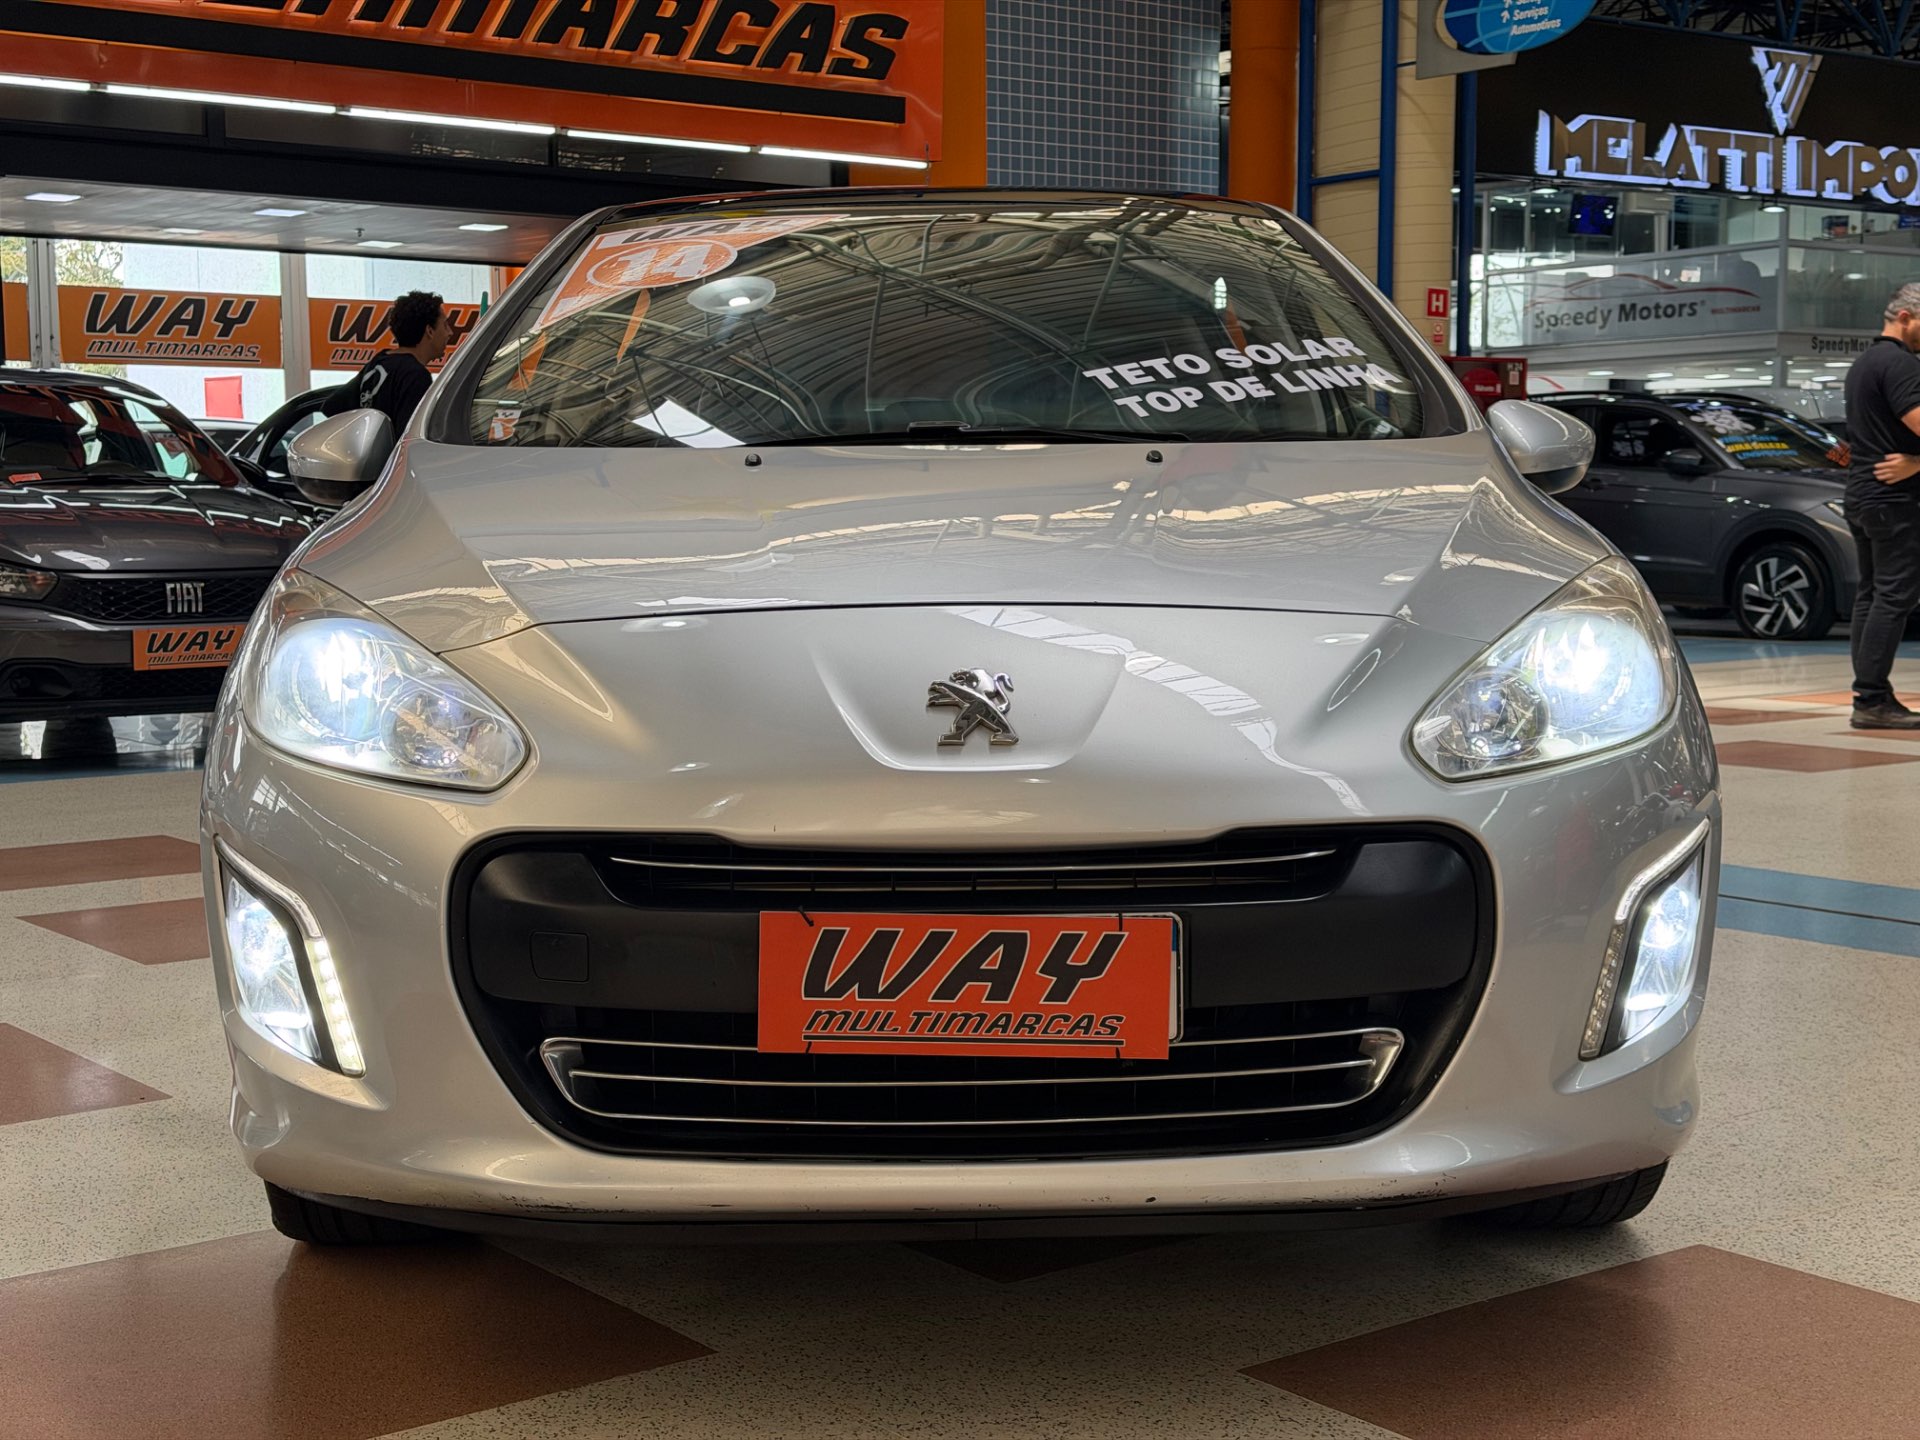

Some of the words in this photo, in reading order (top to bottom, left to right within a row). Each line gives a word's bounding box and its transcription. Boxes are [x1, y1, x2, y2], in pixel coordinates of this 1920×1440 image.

[1510, 18, 1562, 36] Automotivos
[1513, 6, 1549, 20] Serviços
[1535, 109, 1784, 193] MELATTI
[1783, 134, 1920, 206] IMPO
[614, 243, 714, 284] 14
[84, 291, 259, 340] WAY
[1431, 293, 1444, 313] H
[1535, 305, 1612, 332] Speedy
[1617, 300, 1699, 323] Motors
[328, 303, 482, 347] WY
[86, 339, 261, 359] MULTIMARCAS
[1082, 354, 1211, 390] TETO
[1215, 337, 1367, 369] SOLAR
[1113, 386, 1204, 418] TOP
[1207, 376, 1276, 402] DE
[1270, 363, 1403, 394] LINHA
[165, 582, 205, 613] FIAT
[146, 629, 236, 654] WAY
[802, 926, 1129, 1005] WAY
[803, 1008, 1126, 1037] MULTIMARCAS
